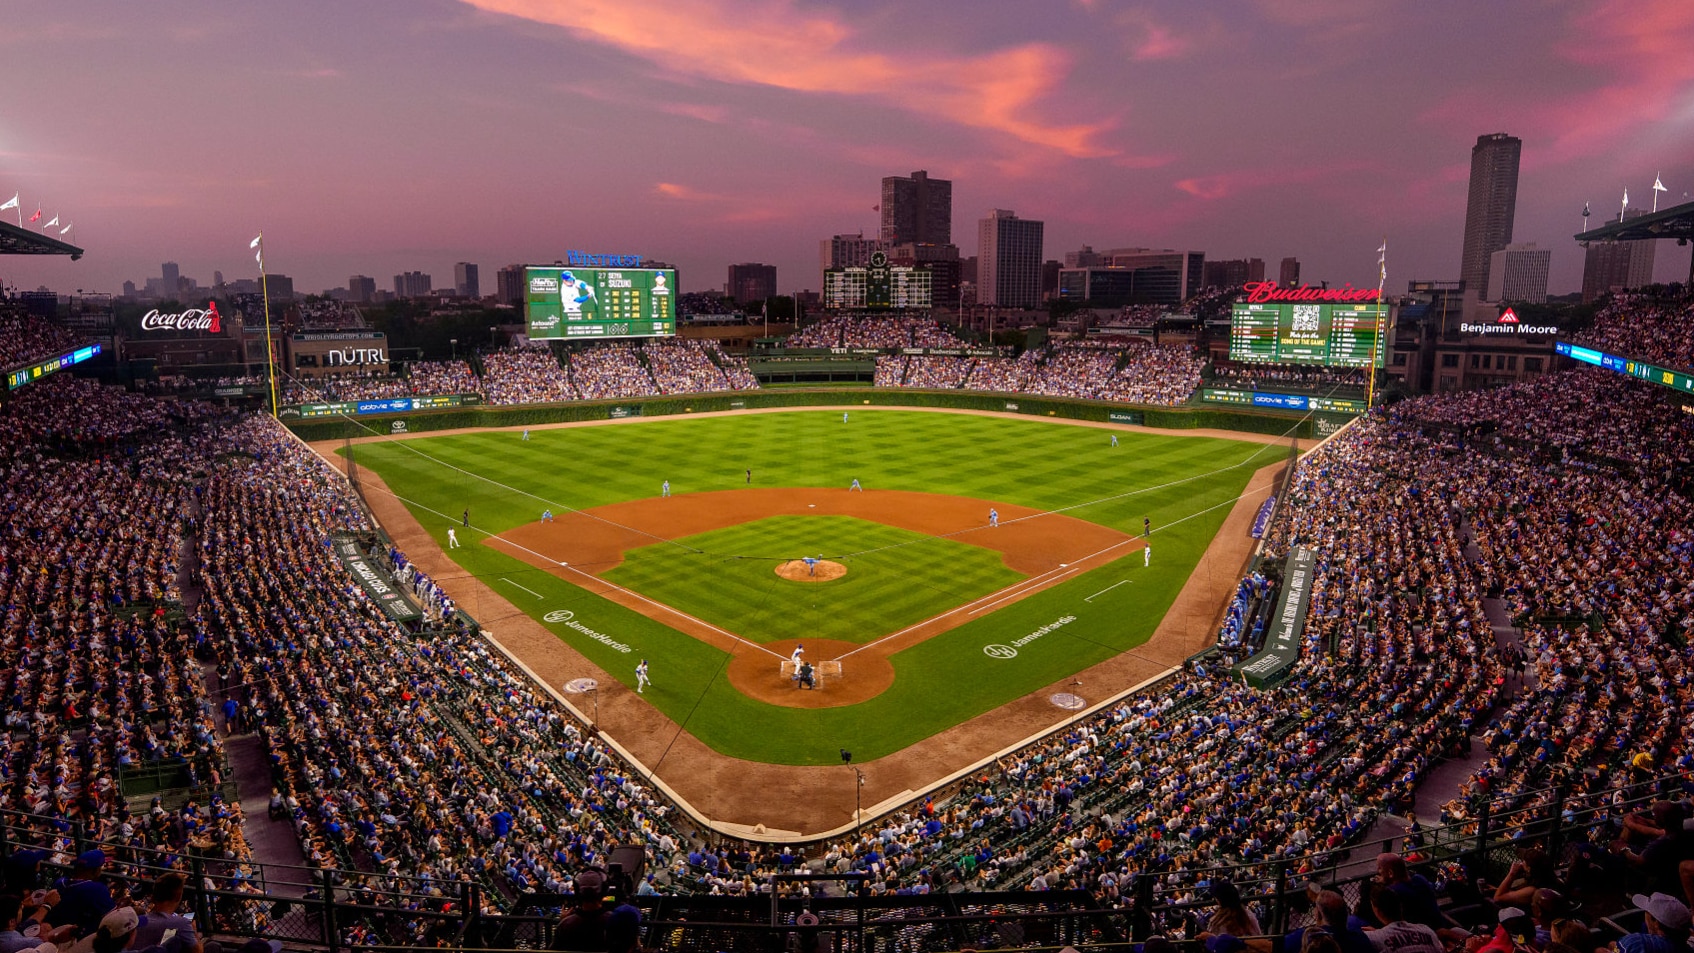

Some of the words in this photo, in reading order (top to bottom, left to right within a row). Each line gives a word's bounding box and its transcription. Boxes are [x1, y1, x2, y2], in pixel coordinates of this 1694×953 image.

[566, 250, 643, 267] WINTRUST
[1243, 281, 1382, 303] Budweiser
[1460, 323, 1514, 334] Benjamin
[1517, 324, 1557, 334] Moore
[1254, 396, 1282, 404] abbvie
[565, 621, 632, 653] JamesHardie
[1010, 615, 1077, 647] JamesHardie
